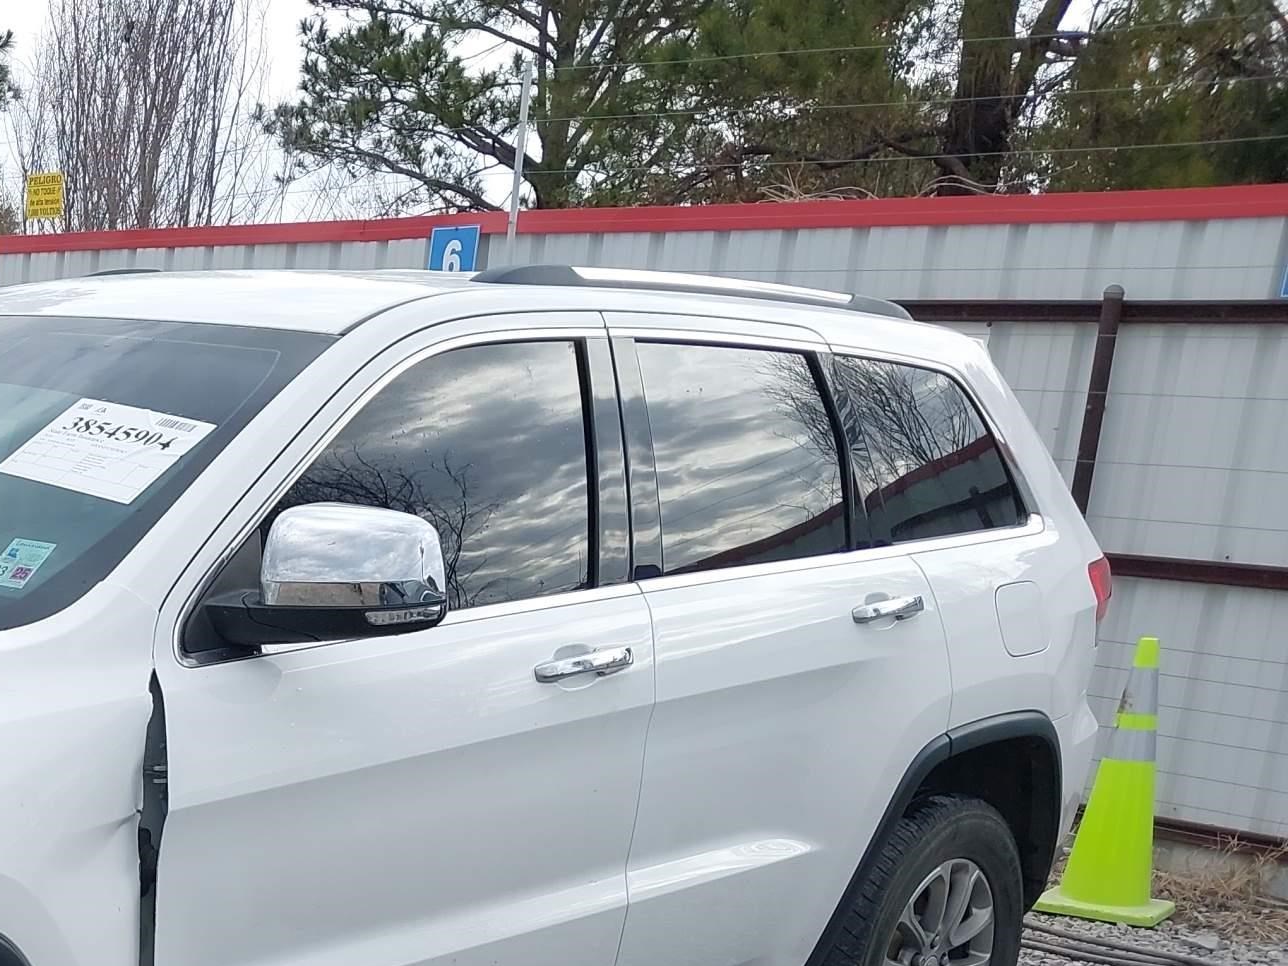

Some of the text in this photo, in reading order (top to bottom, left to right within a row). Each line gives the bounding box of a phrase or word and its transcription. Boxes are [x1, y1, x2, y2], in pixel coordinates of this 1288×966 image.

[29, 175, 62, 185] PELIGRO
[442, 239, 462, 272] 6
[62, 416, 178, 450] 38545904
[13, 567, 29, 579] 25
